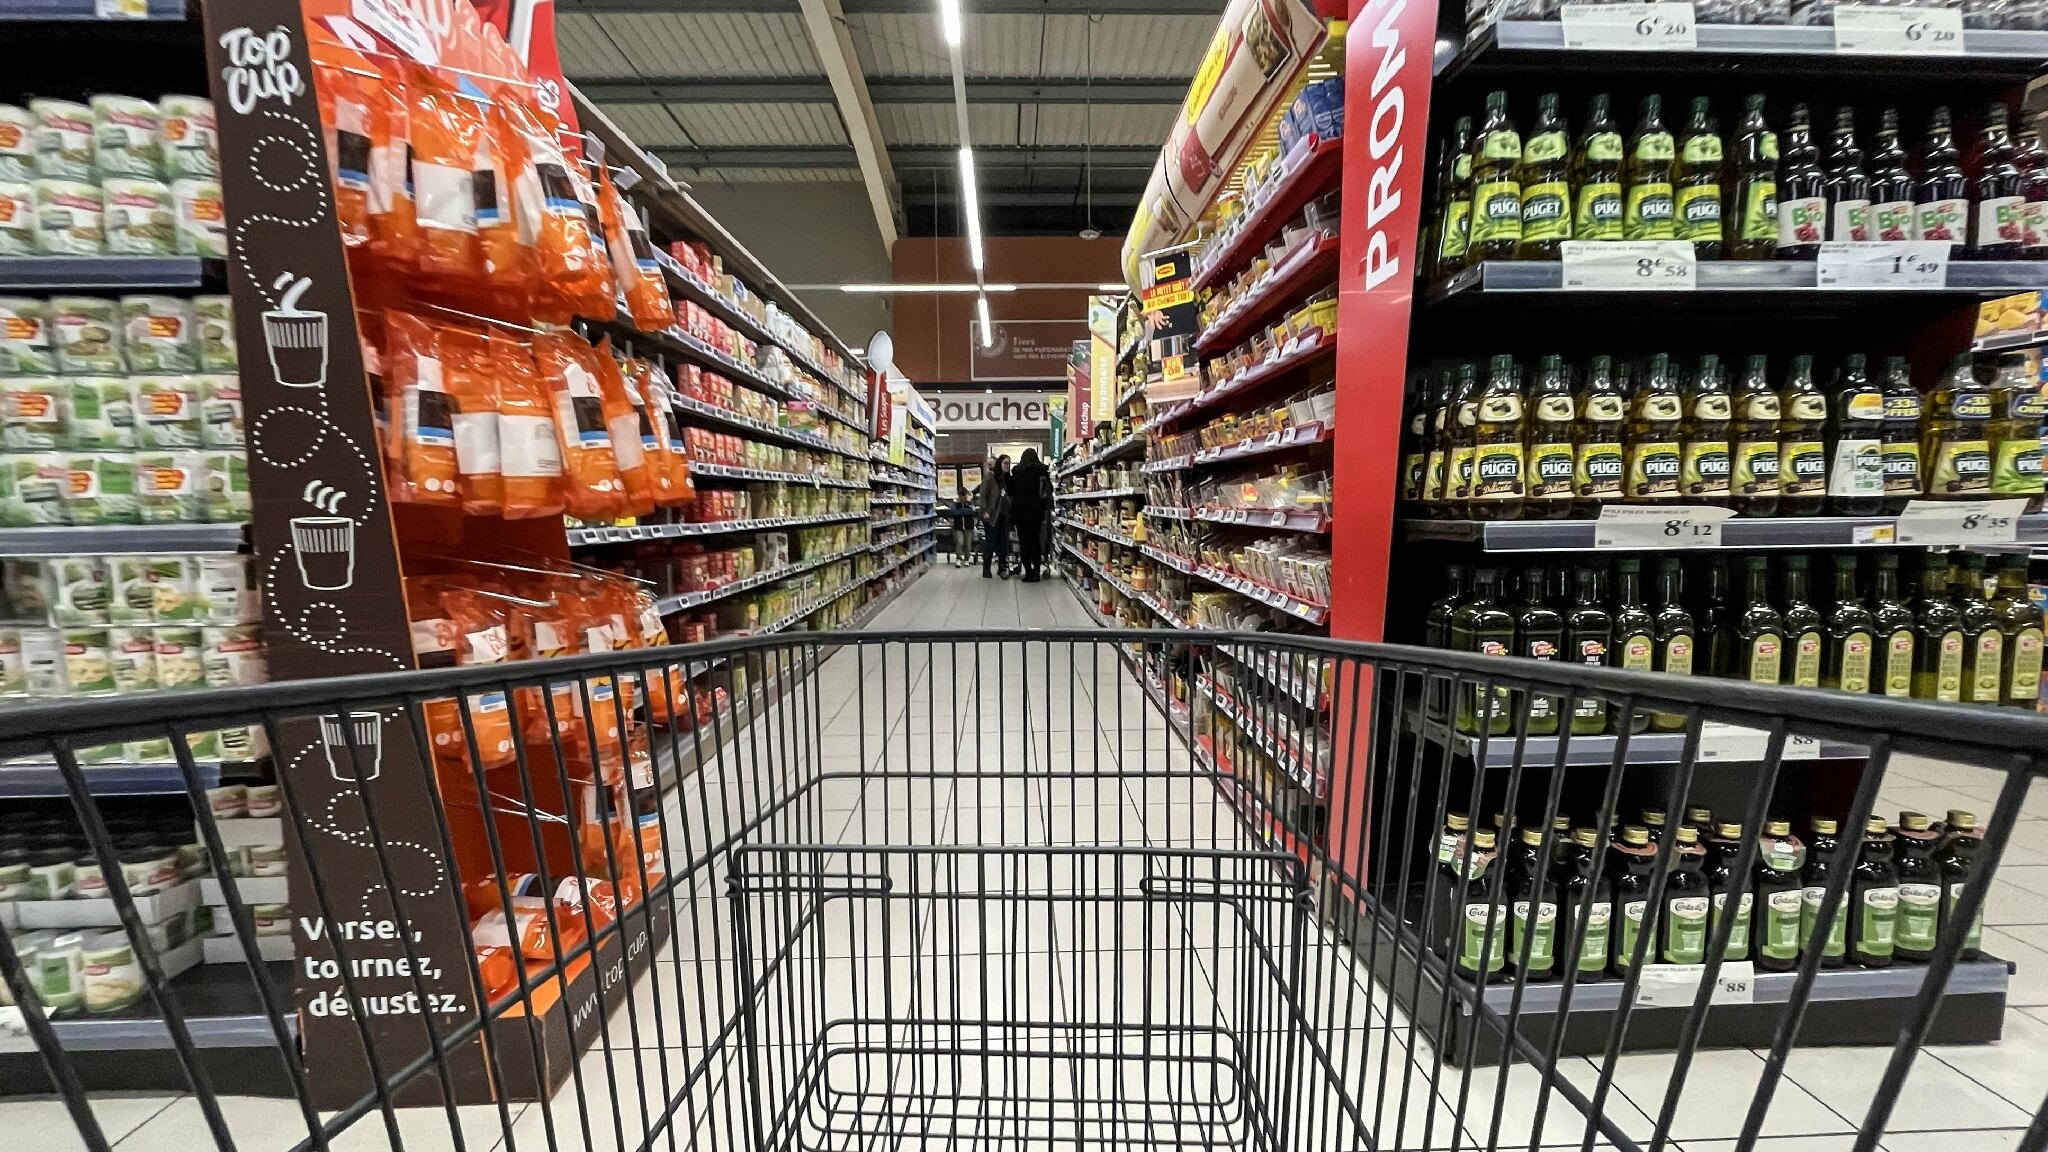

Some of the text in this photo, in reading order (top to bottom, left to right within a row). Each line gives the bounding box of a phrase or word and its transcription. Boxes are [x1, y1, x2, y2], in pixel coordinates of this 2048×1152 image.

[222, 61, 306, 114] Cup
[1523, 202, 1561, 220] PUGET
[1081, 401, 1091, 436] Ketchup
[1481, 463, 1517, 476] PUGET
[300, 917, 422, 943] Vrse,
